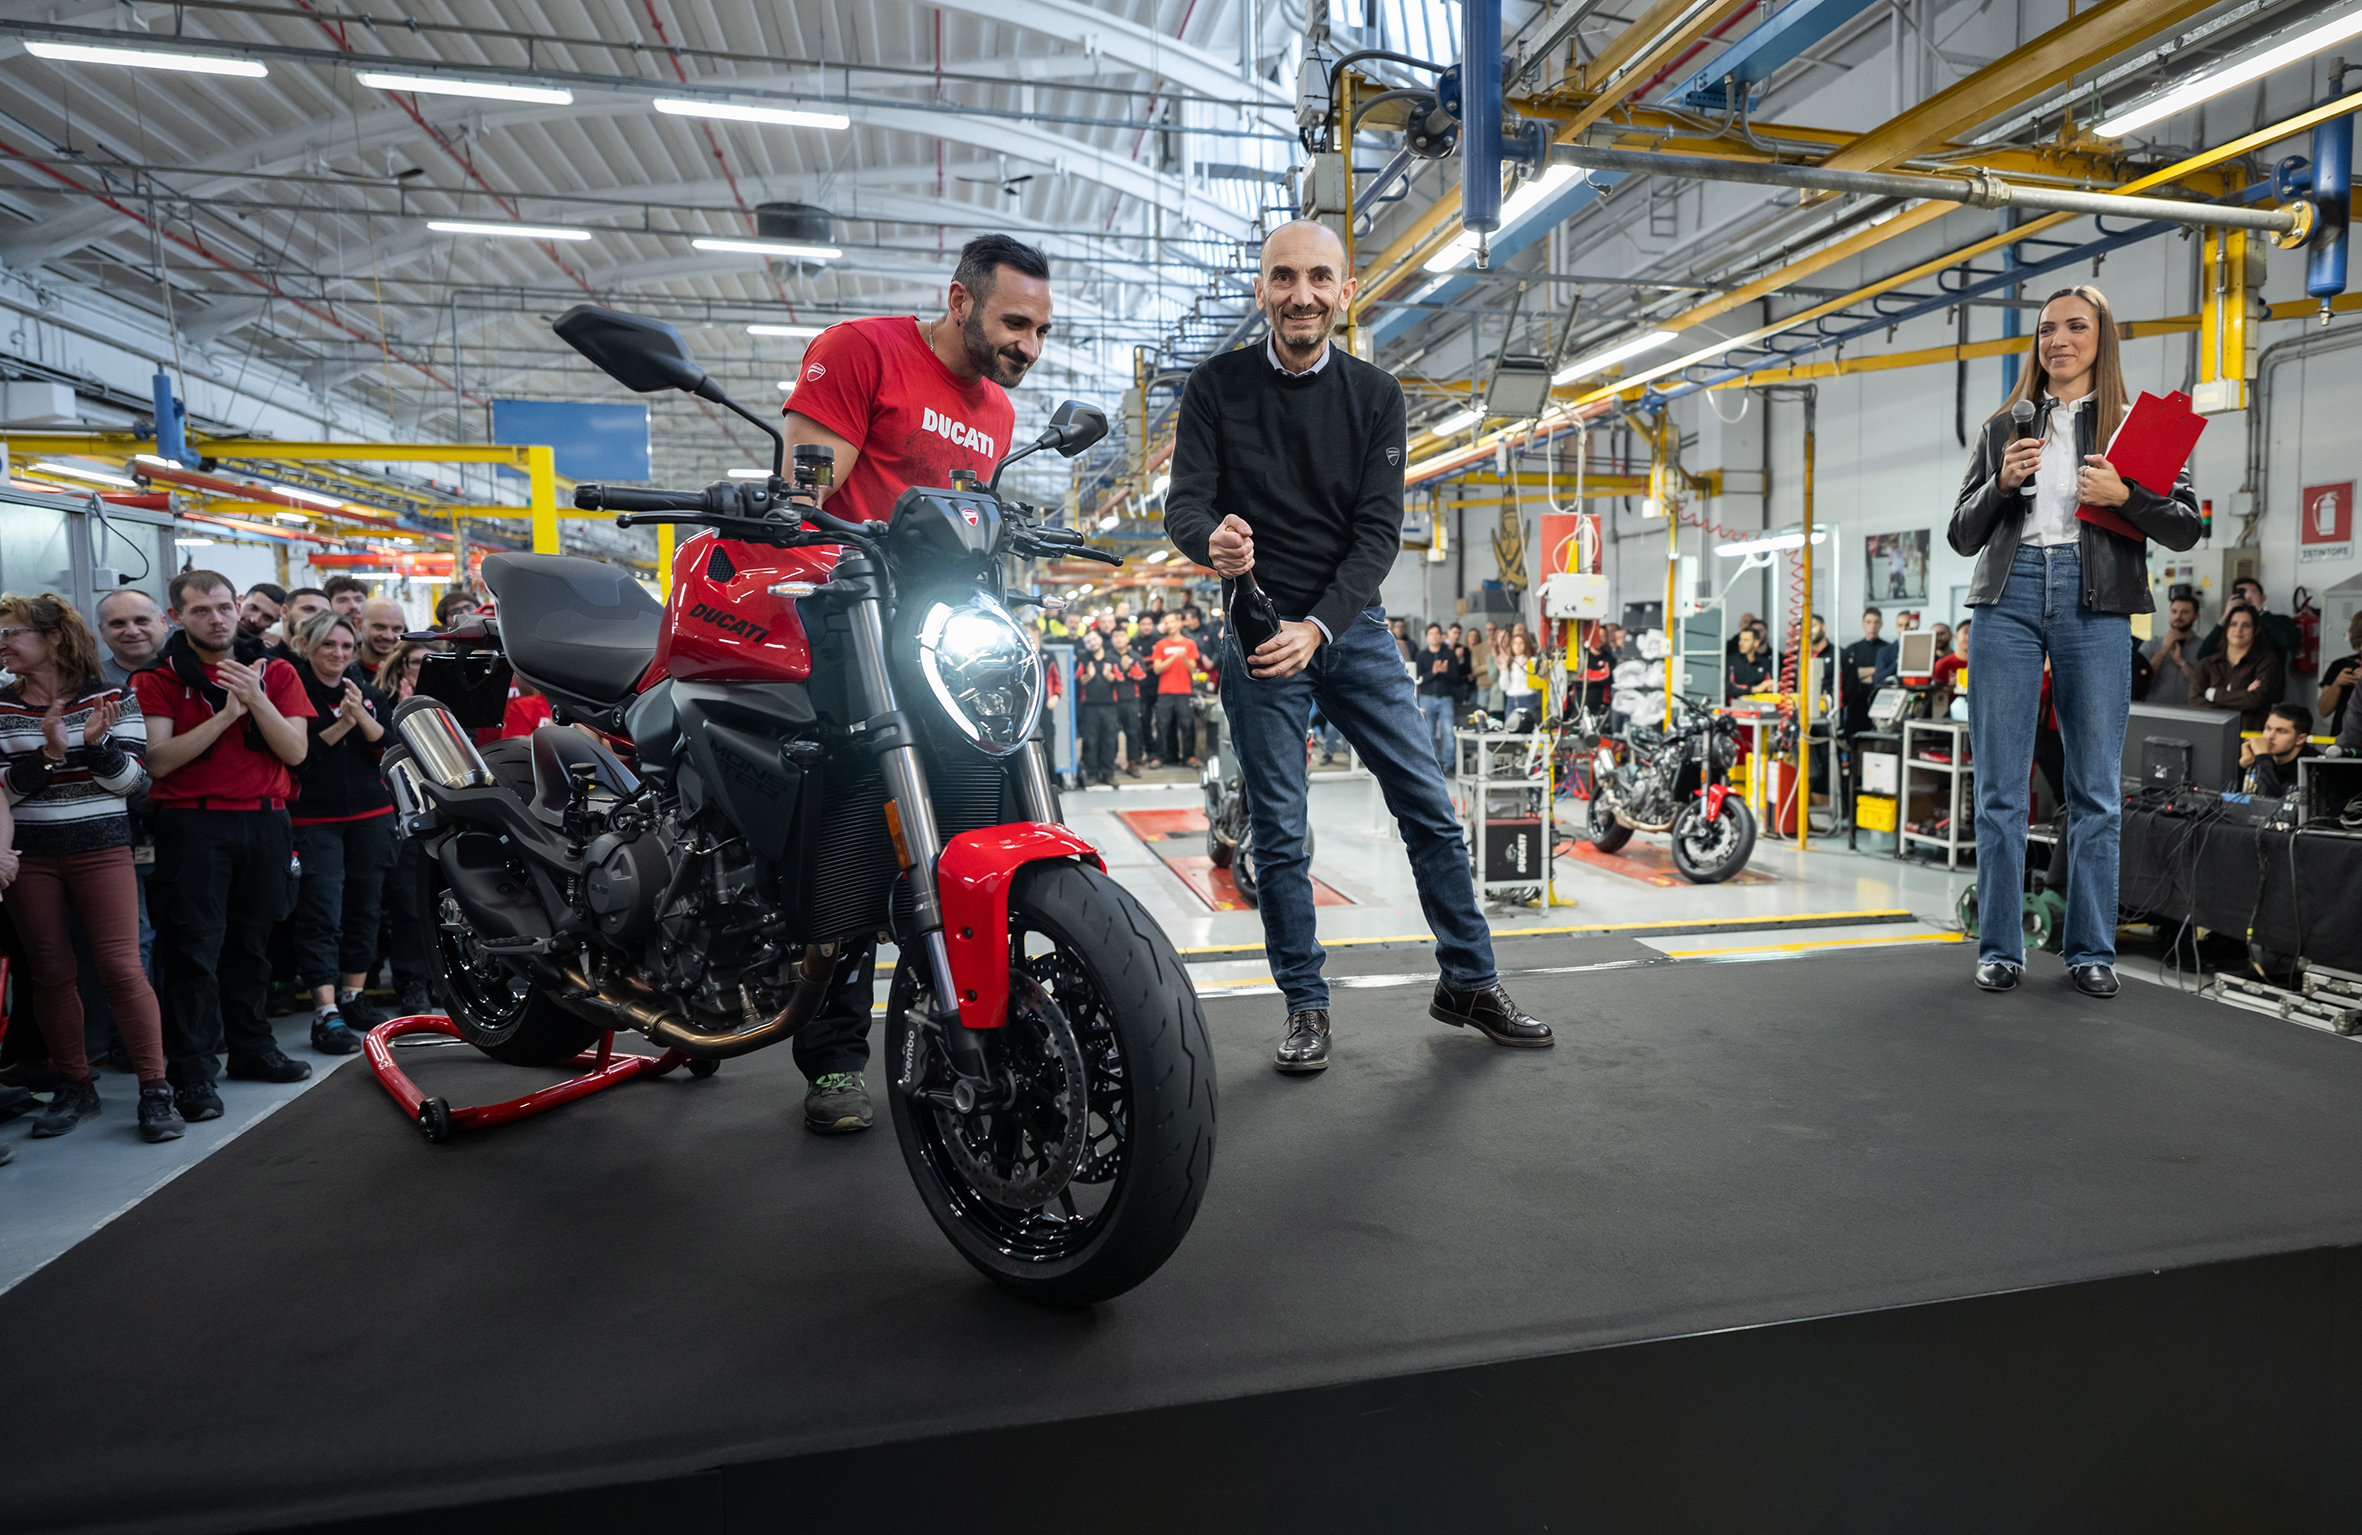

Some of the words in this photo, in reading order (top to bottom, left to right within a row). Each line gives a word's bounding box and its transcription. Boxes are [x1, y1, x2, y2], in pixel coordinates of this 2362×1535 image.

[921, 407, 994, 459] DUCATI
[688, 602, 770, 643] DUCATI
[1517, 833, 1527, 873] DUCATI
[903, 1030, 915, 1083] brembo
